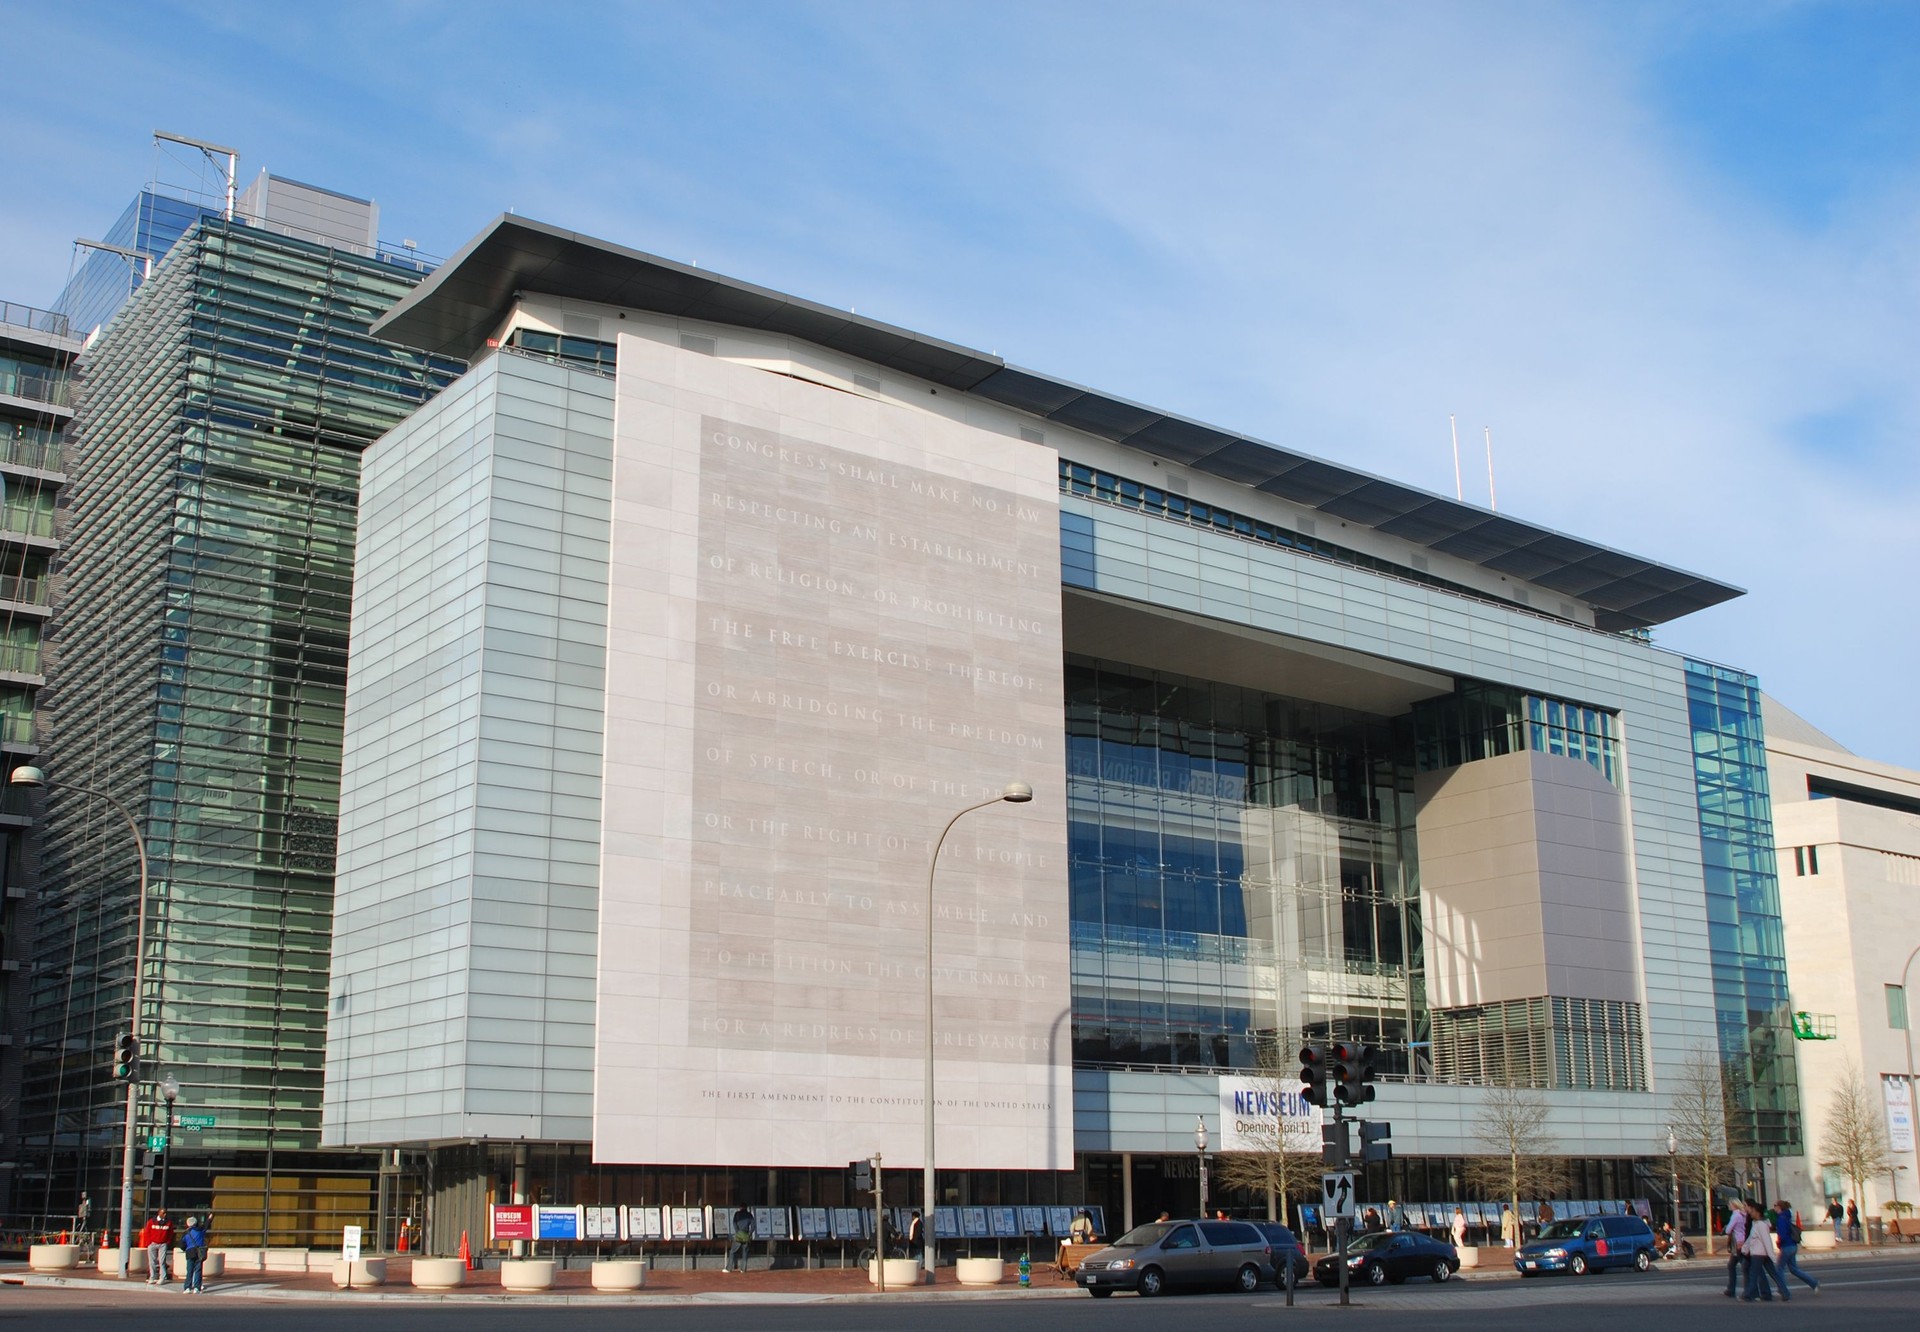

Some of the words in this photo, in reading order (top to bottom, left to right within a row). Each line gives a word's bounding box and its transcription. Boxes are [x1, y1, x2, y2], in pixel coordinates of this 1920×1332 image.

[713, 432, 827, 471] CONGRESS
[839, 462, 898, 489] SHALL
[910, 480, 960, 504] MAKE
[972, 495, 997, 513] NO
[1006, 505, 1040, 523] LAW
[712, 492, 841, 534] RESPECTING
[852, 525, 877, 542] AN
[889, 533, 1039, 578] ESTABLISHMENT
[710, 554, 736, 573] OF
[874, 589, 899, 606] OR
[912, 596, 1042, 635] PROHIBITING
[710, 617, 754, 638] THE
[769, 628, 819, 650] FREE
[834, 641, 932, 673] EXERCISE
[708, 682, 737, 700] OR
[751, 689, 883, 723] ABRIDGING
[897, 713, 936, 732] THE
[950, 723, 1044, 750] FREEDOM
[706, 747, 733, 764] OF
[854, 769, 880, 786] OR
[893, 774, 918, 790] OF
[930, 779, 968, 798] THE
[705, 813, 733, 830] OR
[747, 818, 789, 837] THE
[804, 825, 872, 847] RIGHT
[887, 836, 911, 851] OF
[923, 840, 961, 858] THE
[976, 846, 1046, 868] PEOPLE
[704, 880, 832, 907] PEACEABLY
[845, 895, 872, 911] TO
[886, 899, 996, 925] ASSMBLE,
[1010, 912, 1048, 929] AND
[703, 947, 731, 964] TO
[748, 951, 852, 975] PETITION
[865, 961, 902, 977] THE
[702, 1017, 745, 1035] FOR
[758, 1021, 772, 1036] A
[784, 1022, 877, 1042] REDRESS
[890, 1029, 913, 1045] OF
[702, 1090, 722, 1098] THE
[727, 1091, 756, 1100] FIRST
[760, 1092, 825, 1103] AMENDMENT
[847, 1096, 865, 1104] THE
[870, 1097, 942, 1107] CONSTITUTN
[963, 1100, 980, 1108] THE
[984, 1101, 1018, 1110] UNITED
[1022, 1103, 1052, 1111] STATES
[1234, 1090, 1310, 1116] NEWSEUM
[1236, 1120, 1276, 1136] Opening
[1301, 1122, 1310, 1134] 11
